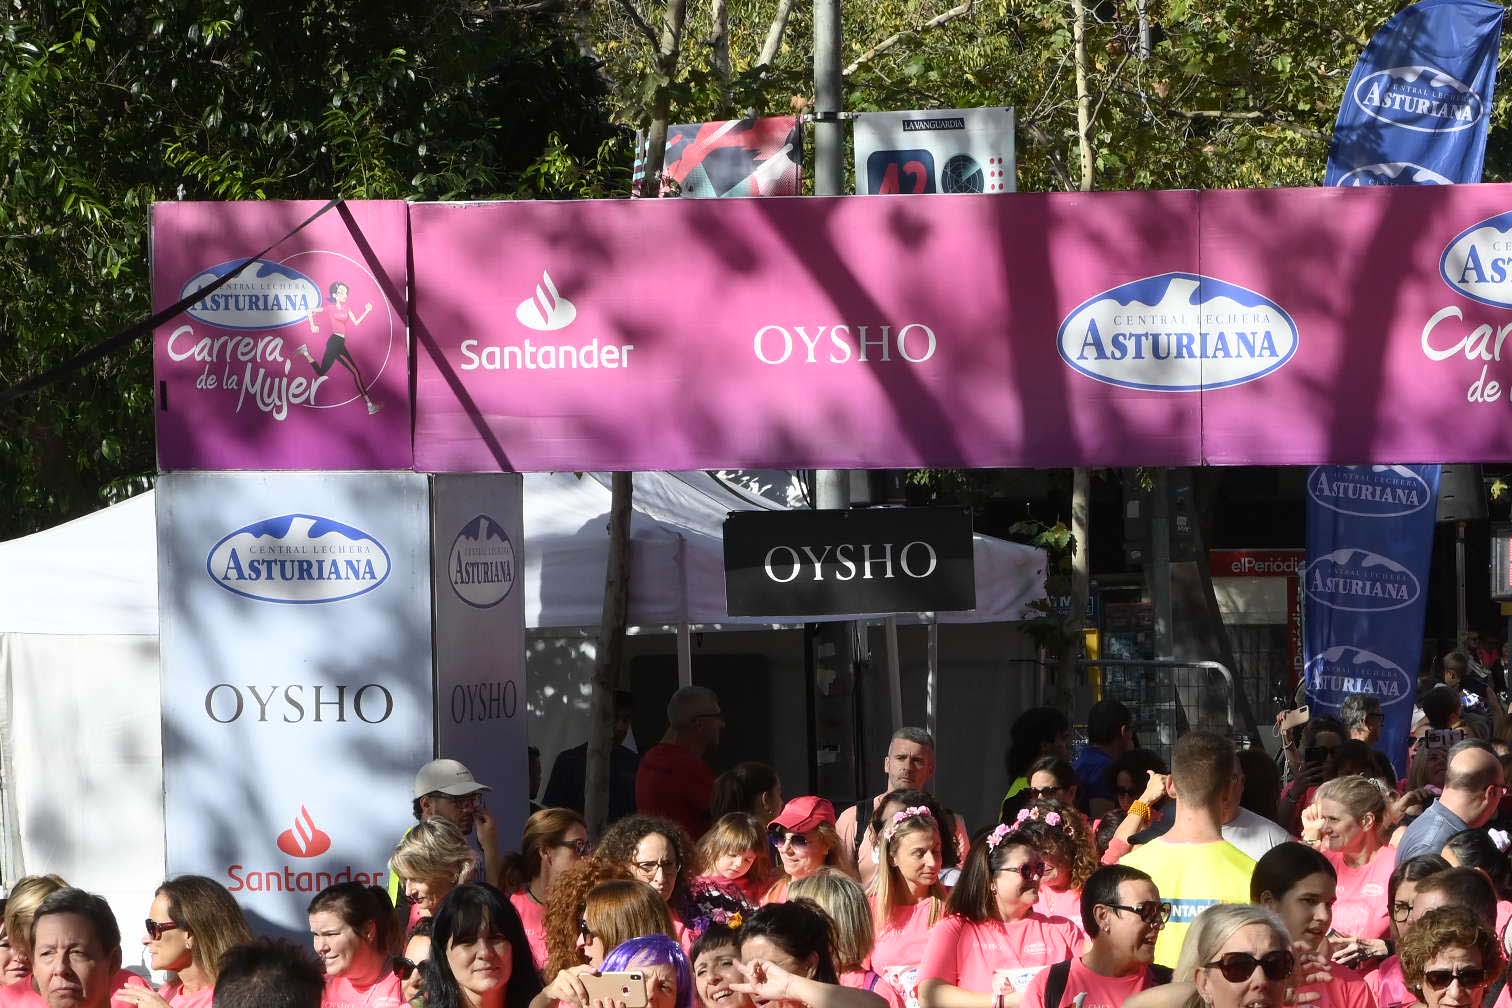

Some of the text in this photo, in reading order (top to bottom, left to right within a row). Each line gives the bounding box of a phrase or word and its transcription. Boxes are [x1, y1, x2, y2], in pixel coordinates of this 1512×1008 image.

[1363, 82, 1473, 121] ASTURIANA
[220, 283, 256, 291] ENTRAL
[1113, 313, 1271, 326] CENTRAL LECHERA
[167, 325, 284, 362] Carrera
[460, 338, 634, 371] Santander
[753, 323, 937, 365] OYSHO
[1077, 318, 1279, 361] ASTURIANA
[197, 360, 328, 421] de la Mujer
[1467, 364, 1502, 404] de
[1315, 472, 1420, 507] ASTURIANA
[222, 547, 378, 582] ASTURIANA
[249, 543, 372, 555] CENTRAL LECHERA
[764, 541, 937, 583] OYSHO
[454, 551, 512, 585] ASTURIANA
[1310, 569, 1409, 600] ASTURIANA
[204, 683, 394, 724] OYSHO
[451, 679, 517, 726] OYSHO
[1172, 904, 1204, 917] NTA
